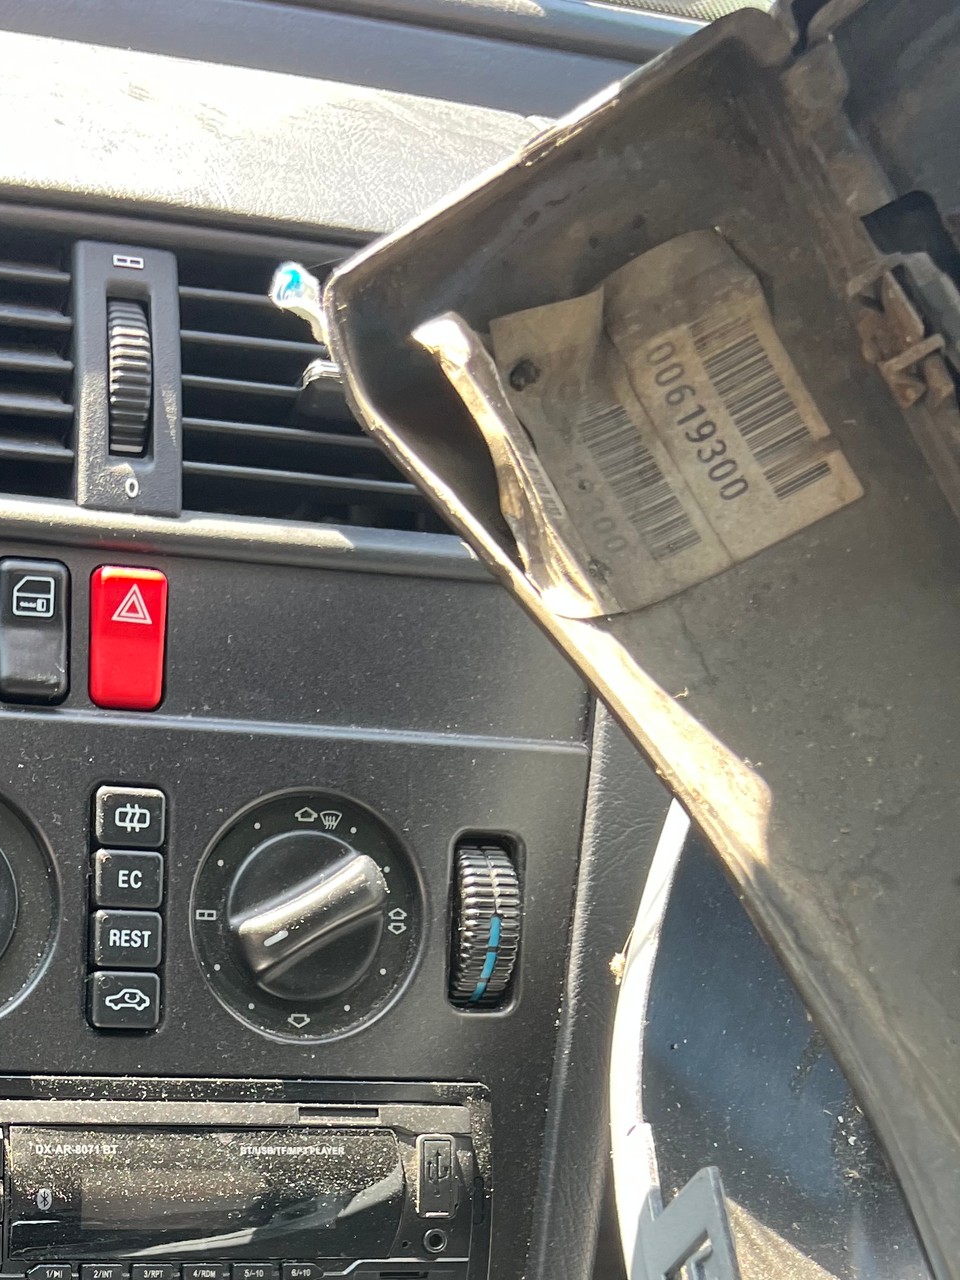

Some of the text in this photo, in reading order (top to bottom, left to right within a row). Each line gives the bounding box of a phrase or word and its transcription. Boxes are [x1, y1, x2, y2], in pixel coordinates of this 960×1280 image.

[645, 341, 749, 501] 00619300
[117, 870, 143, 889] EC
[109, 929, 151, 948] REST
[35, 1144, 119, 1155] DX-AR-8071 BT
[93, 1270, 113, 1279] 2/INT
[143, 1270, 164, 1278] 3/RPT
[192, 1269, 216, 1278] 4/RDM
